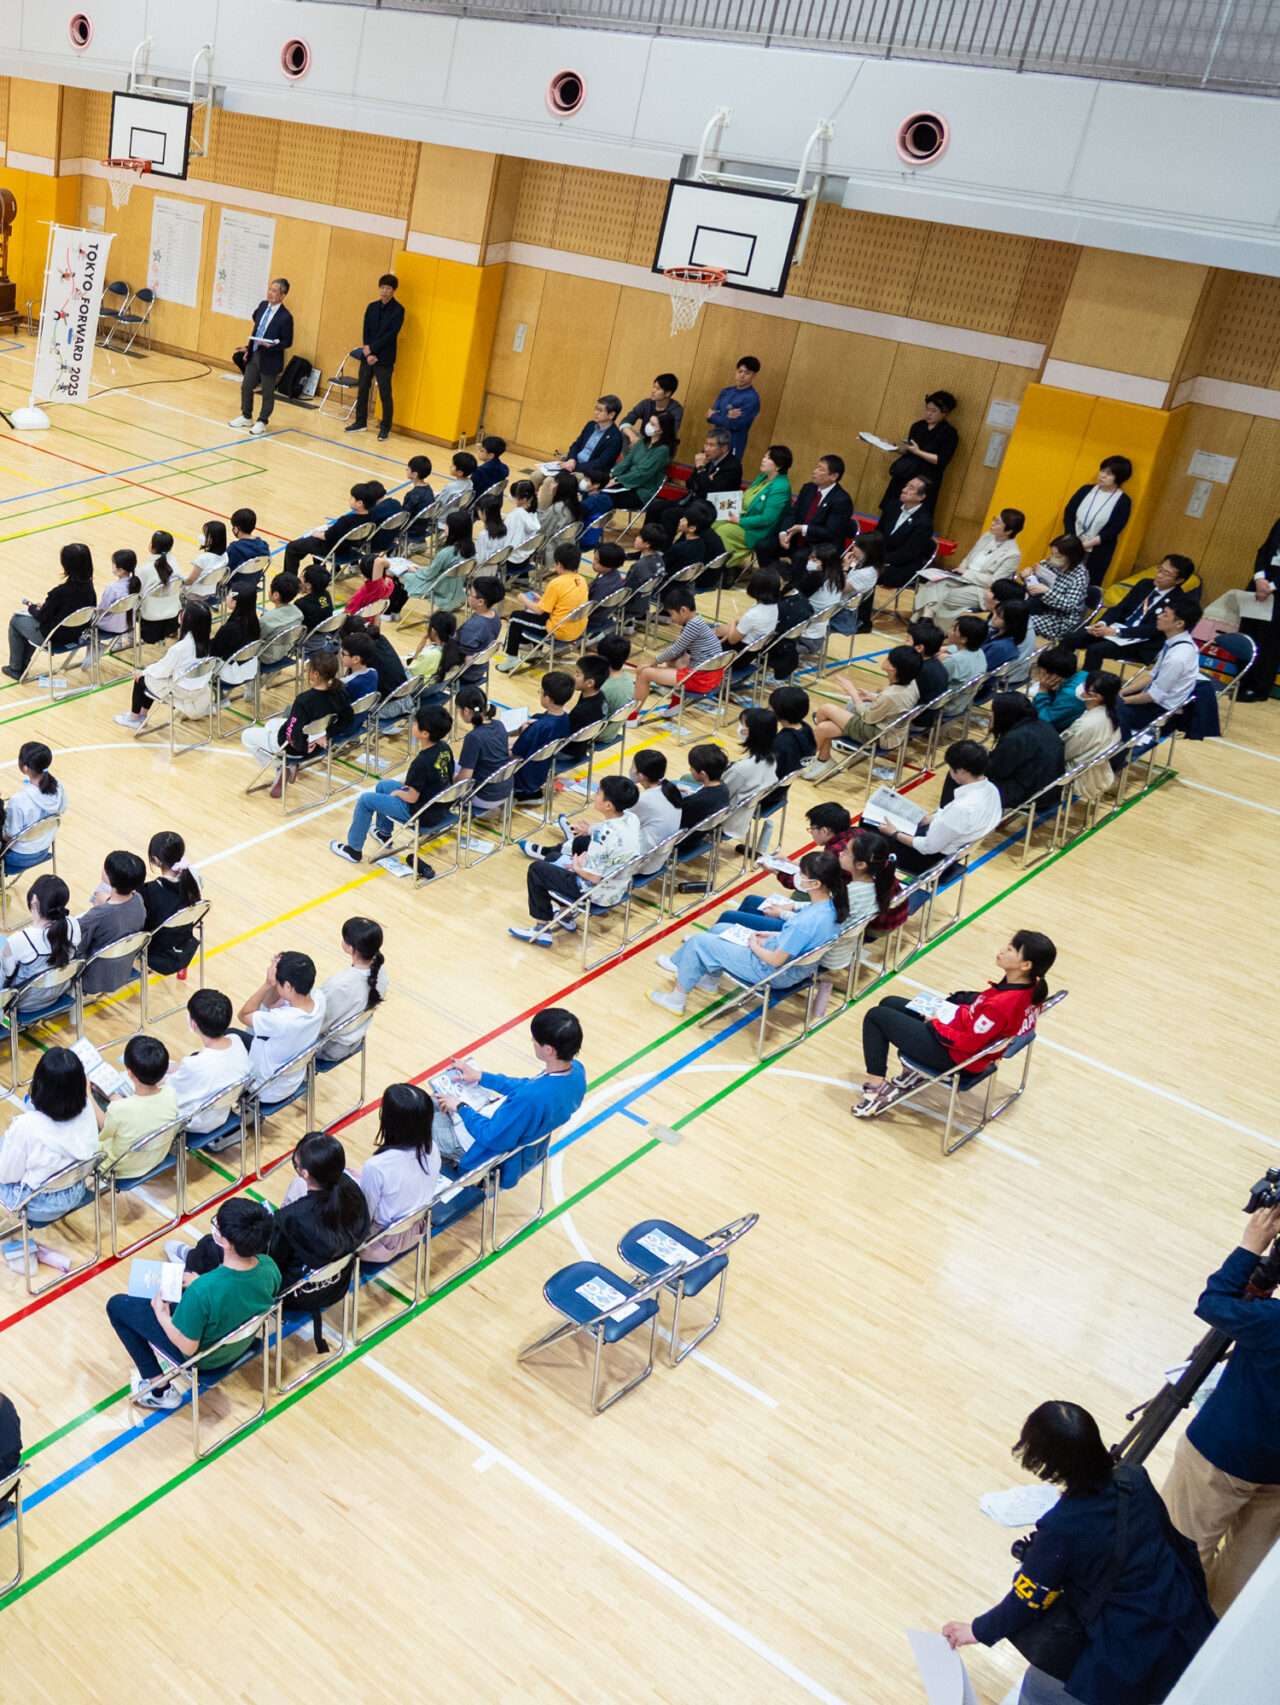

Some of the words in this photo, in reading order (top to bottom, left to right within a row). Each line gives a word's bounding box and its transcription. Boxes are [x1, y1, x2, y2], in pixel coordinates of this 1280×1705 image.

[82, 243, 99, 292] TOKYO
[72, 297, 90, 362] FORWARD
[68, 367, 81, 396] 2025
